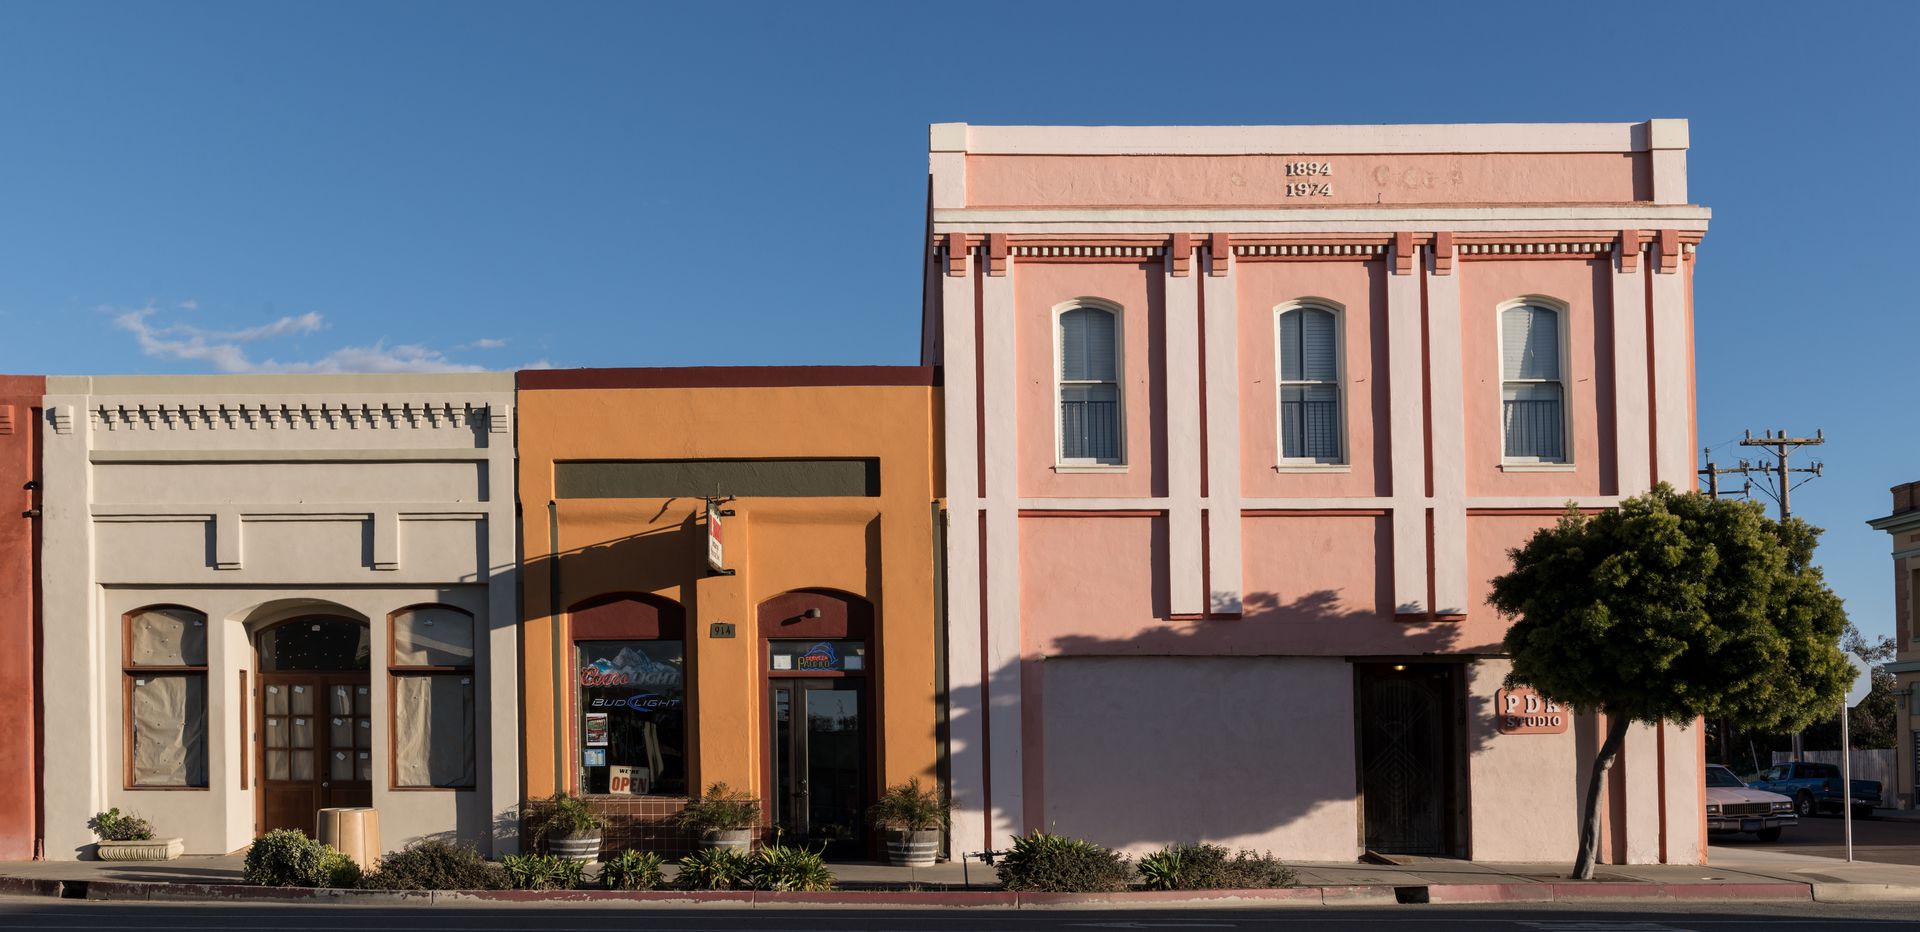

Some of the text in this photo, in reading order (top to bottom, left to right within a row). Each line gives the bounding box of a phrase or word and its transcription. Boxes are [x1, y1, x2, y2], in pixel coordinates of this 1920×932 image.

[1285, 162, 1332, 177] 1894
[1286, 183, 1333, 197] 1974
[581, 667, 680, 687] Coors LIGHT
[592, 698, 680, 707] BUD LIGHT
[1505, 716, 1561, 727] STUDIO
[611, 776, 648, 793] OPEN
